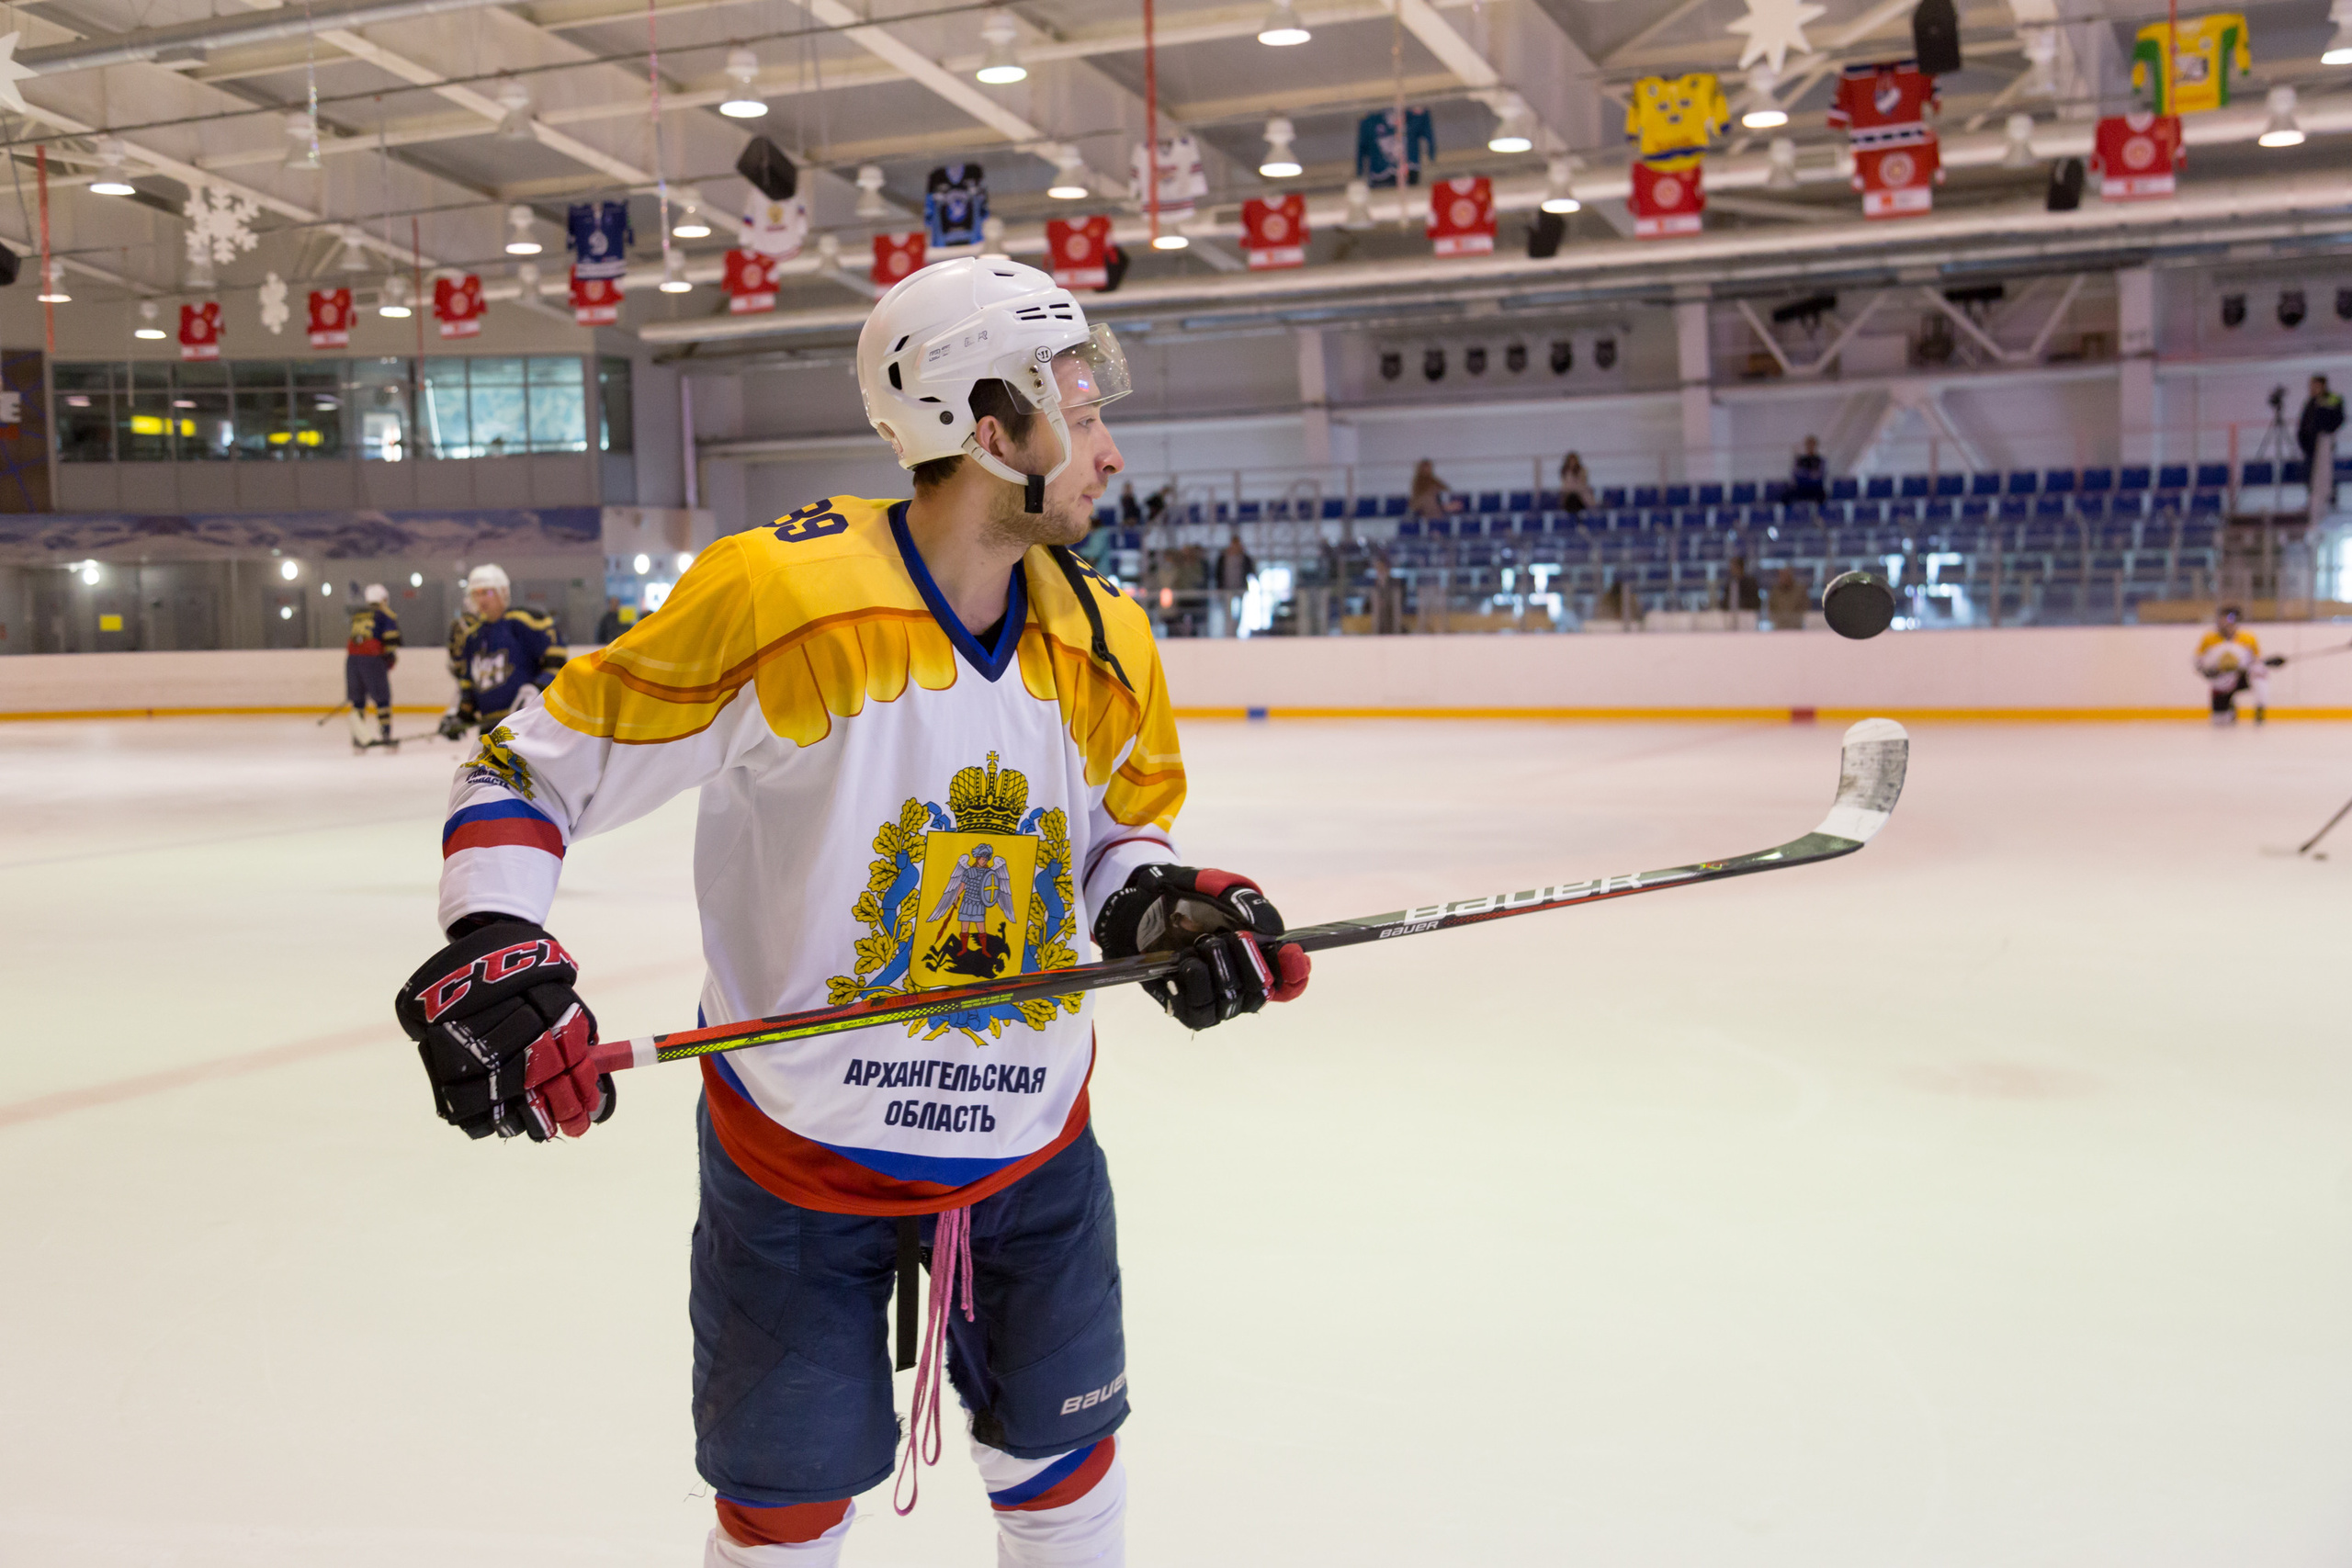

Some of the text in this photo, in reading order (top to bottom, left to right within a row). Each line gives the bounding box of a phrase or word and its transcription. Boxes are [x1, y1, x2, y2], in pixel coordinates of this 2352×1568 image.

[1379, 920, 1440, 939] BAUER
[842, 1058, 1047, 1094] АРХАНГЕЛЬСКАЯ
[884, 1100, 996, 1133] ОБЛАСТЬ
[1059, 1371, 1126, 1416] BAUE
